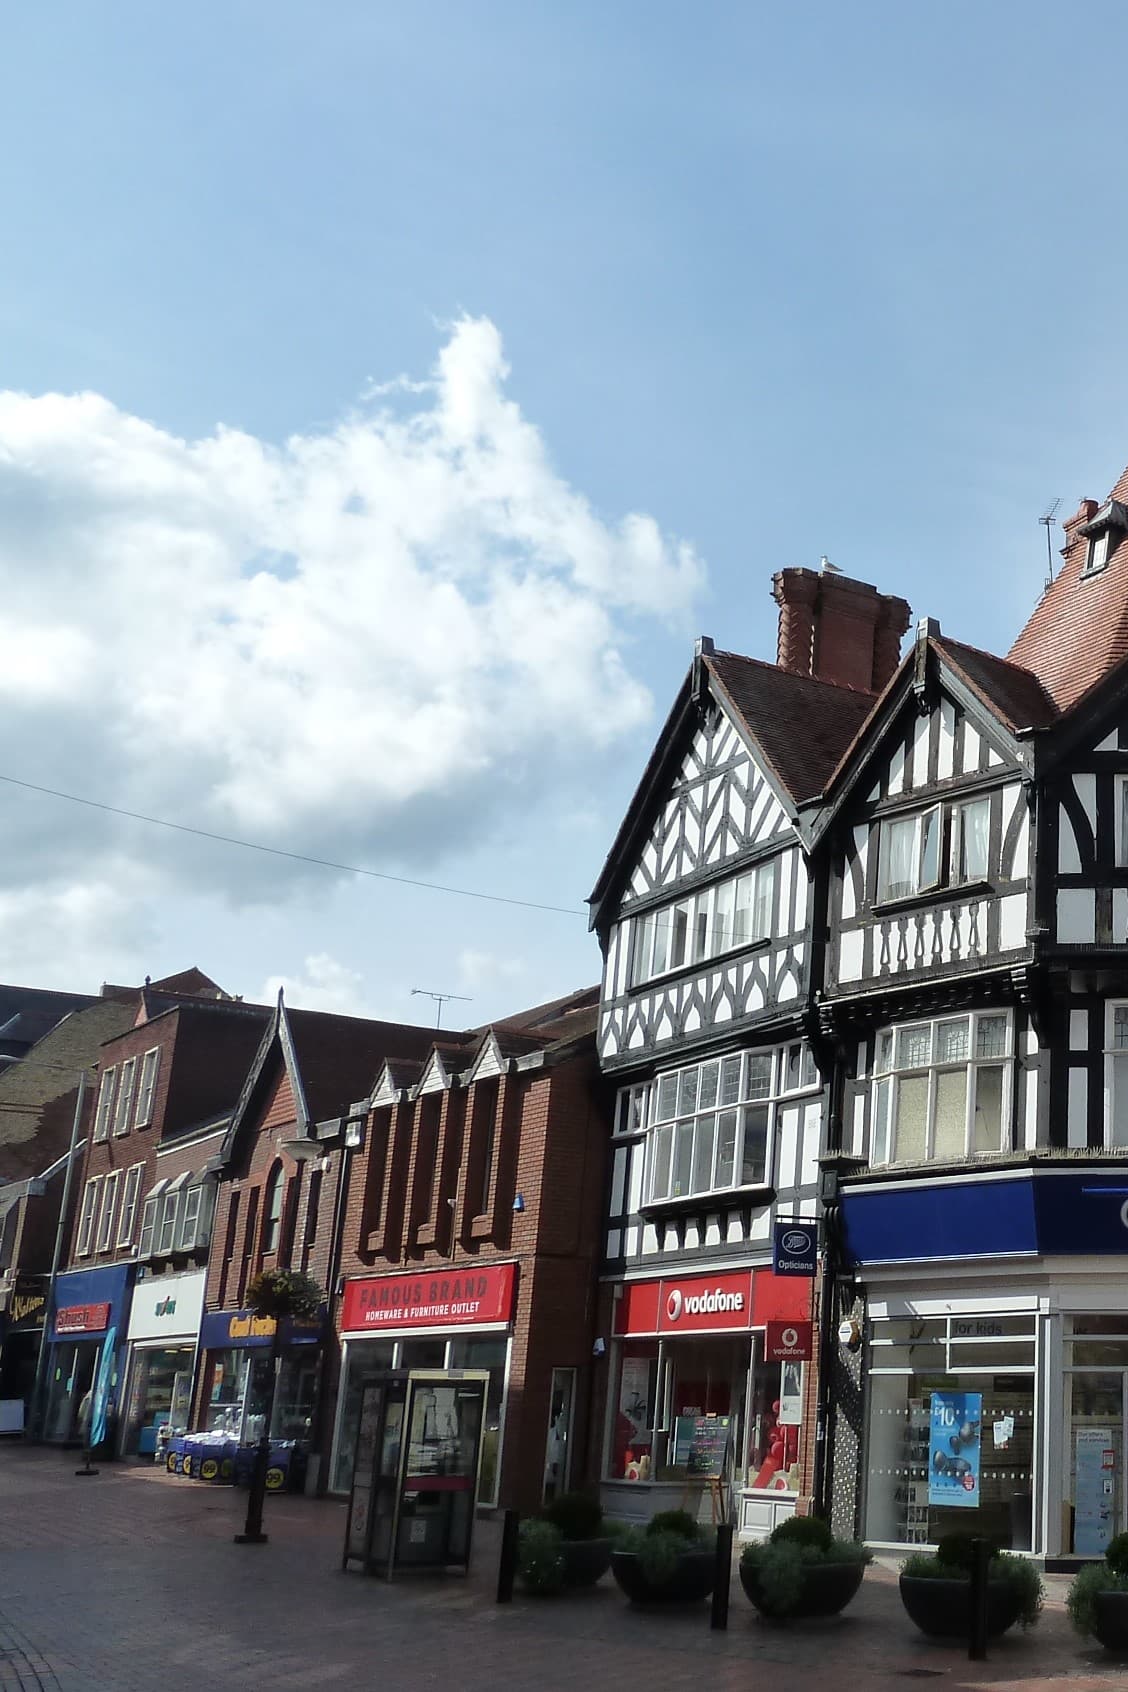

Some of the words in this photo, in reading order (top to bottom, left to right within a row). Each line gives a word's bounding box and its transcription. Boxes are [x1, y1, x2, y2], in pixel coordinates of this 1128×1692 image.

[778, 1260, 814, 1271] Opticians
[359, 1283, 423, 1309] FAMOUS
[429, 1276, 488, 1303] BRAND
[684, 1288, 744, 1314] vodafone
[365, 1308, 403, 1321] HOMEWARE
[403, 1308, 409, 1319] &
[410, 1304, 449, 1317] FURNITURE
[451, 1301, 480, 1315] OUTLET
[955, 1321, 973, 1334] for
[976, 1320, 1002, 1334] kids
[772, 1346, 806, 1356] vodafone
